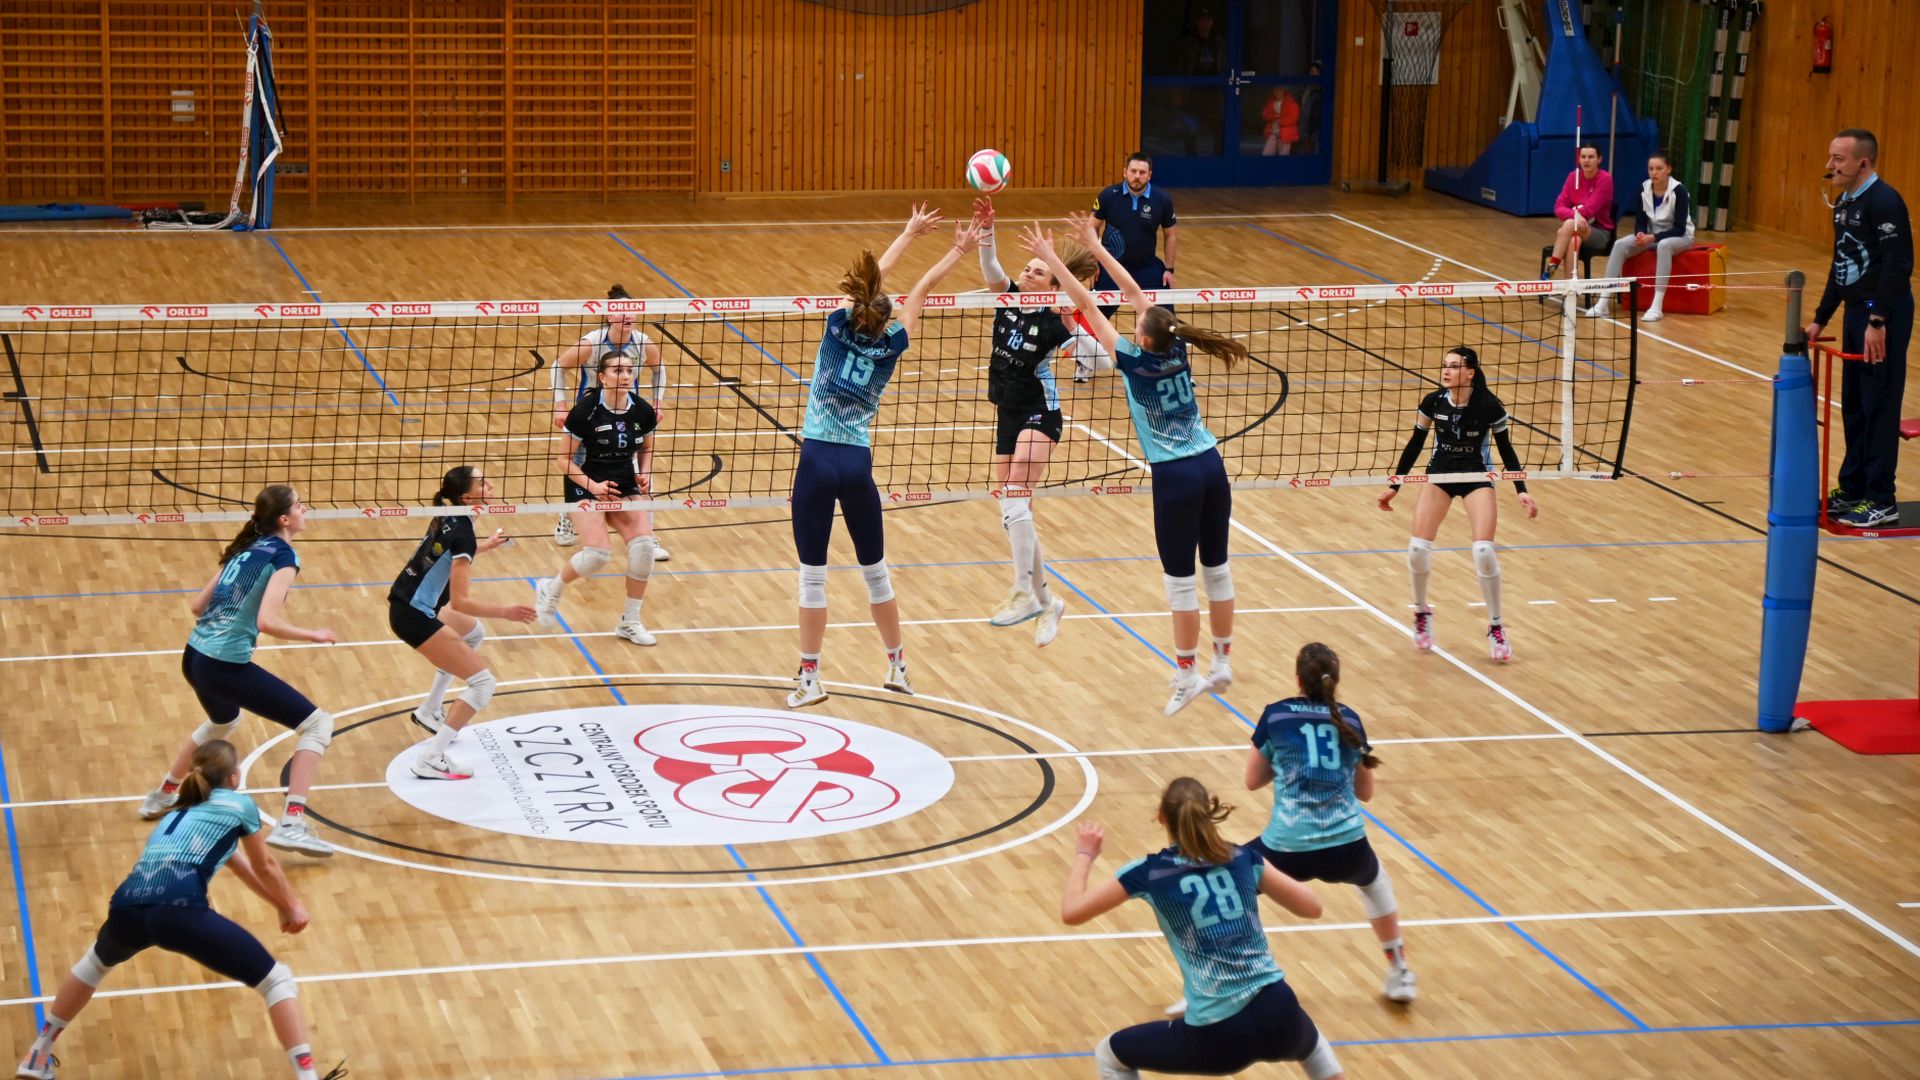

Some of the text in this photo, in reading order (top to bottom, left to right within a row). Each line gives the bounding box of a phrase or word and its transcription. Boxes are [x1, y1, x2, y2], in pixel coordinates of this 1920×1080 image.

[1420, 286, 1452, 295] ORLEN
[1518, 283, 1551, 292] ORLEN
[1222, 290, 1254, 299] ORLEN
[1321, 288, 1353, 297] ORLEN
[1021, 295, 1055, 303] ORLEN
[502, 304, 538, 313] ORLEN
[609, 302, 644, 311] ORLEN
[714, 300, 749, 309] ORLEN
[51, 308, 91, 317] ORLEN
[168, 307, 206, 316] ORLEN
[282, 306, 319, 315] ORLEN
[393, 305, 430, 314] ORLEN
[1007, 329, 1024, 350] 18
[840, 351, 876, 386] 19
[1156, 371, 1193, 411] 20
[1451, 425, 1460, 440] 4
[618, 433, 628, 448] 6
[40, 517, 68, 525] ORLEN
[156, 514, 184, 522] ORLEN
[218, 551, 251, 586] 16
[1299, 723, 1341, 770] 13
[506, 725, 628, 832] SZCZYRK
[579, 722, 673, 828] CENTRALNY OŚRODEK SPORTU
[1179, 867, 1244, 929] 28
